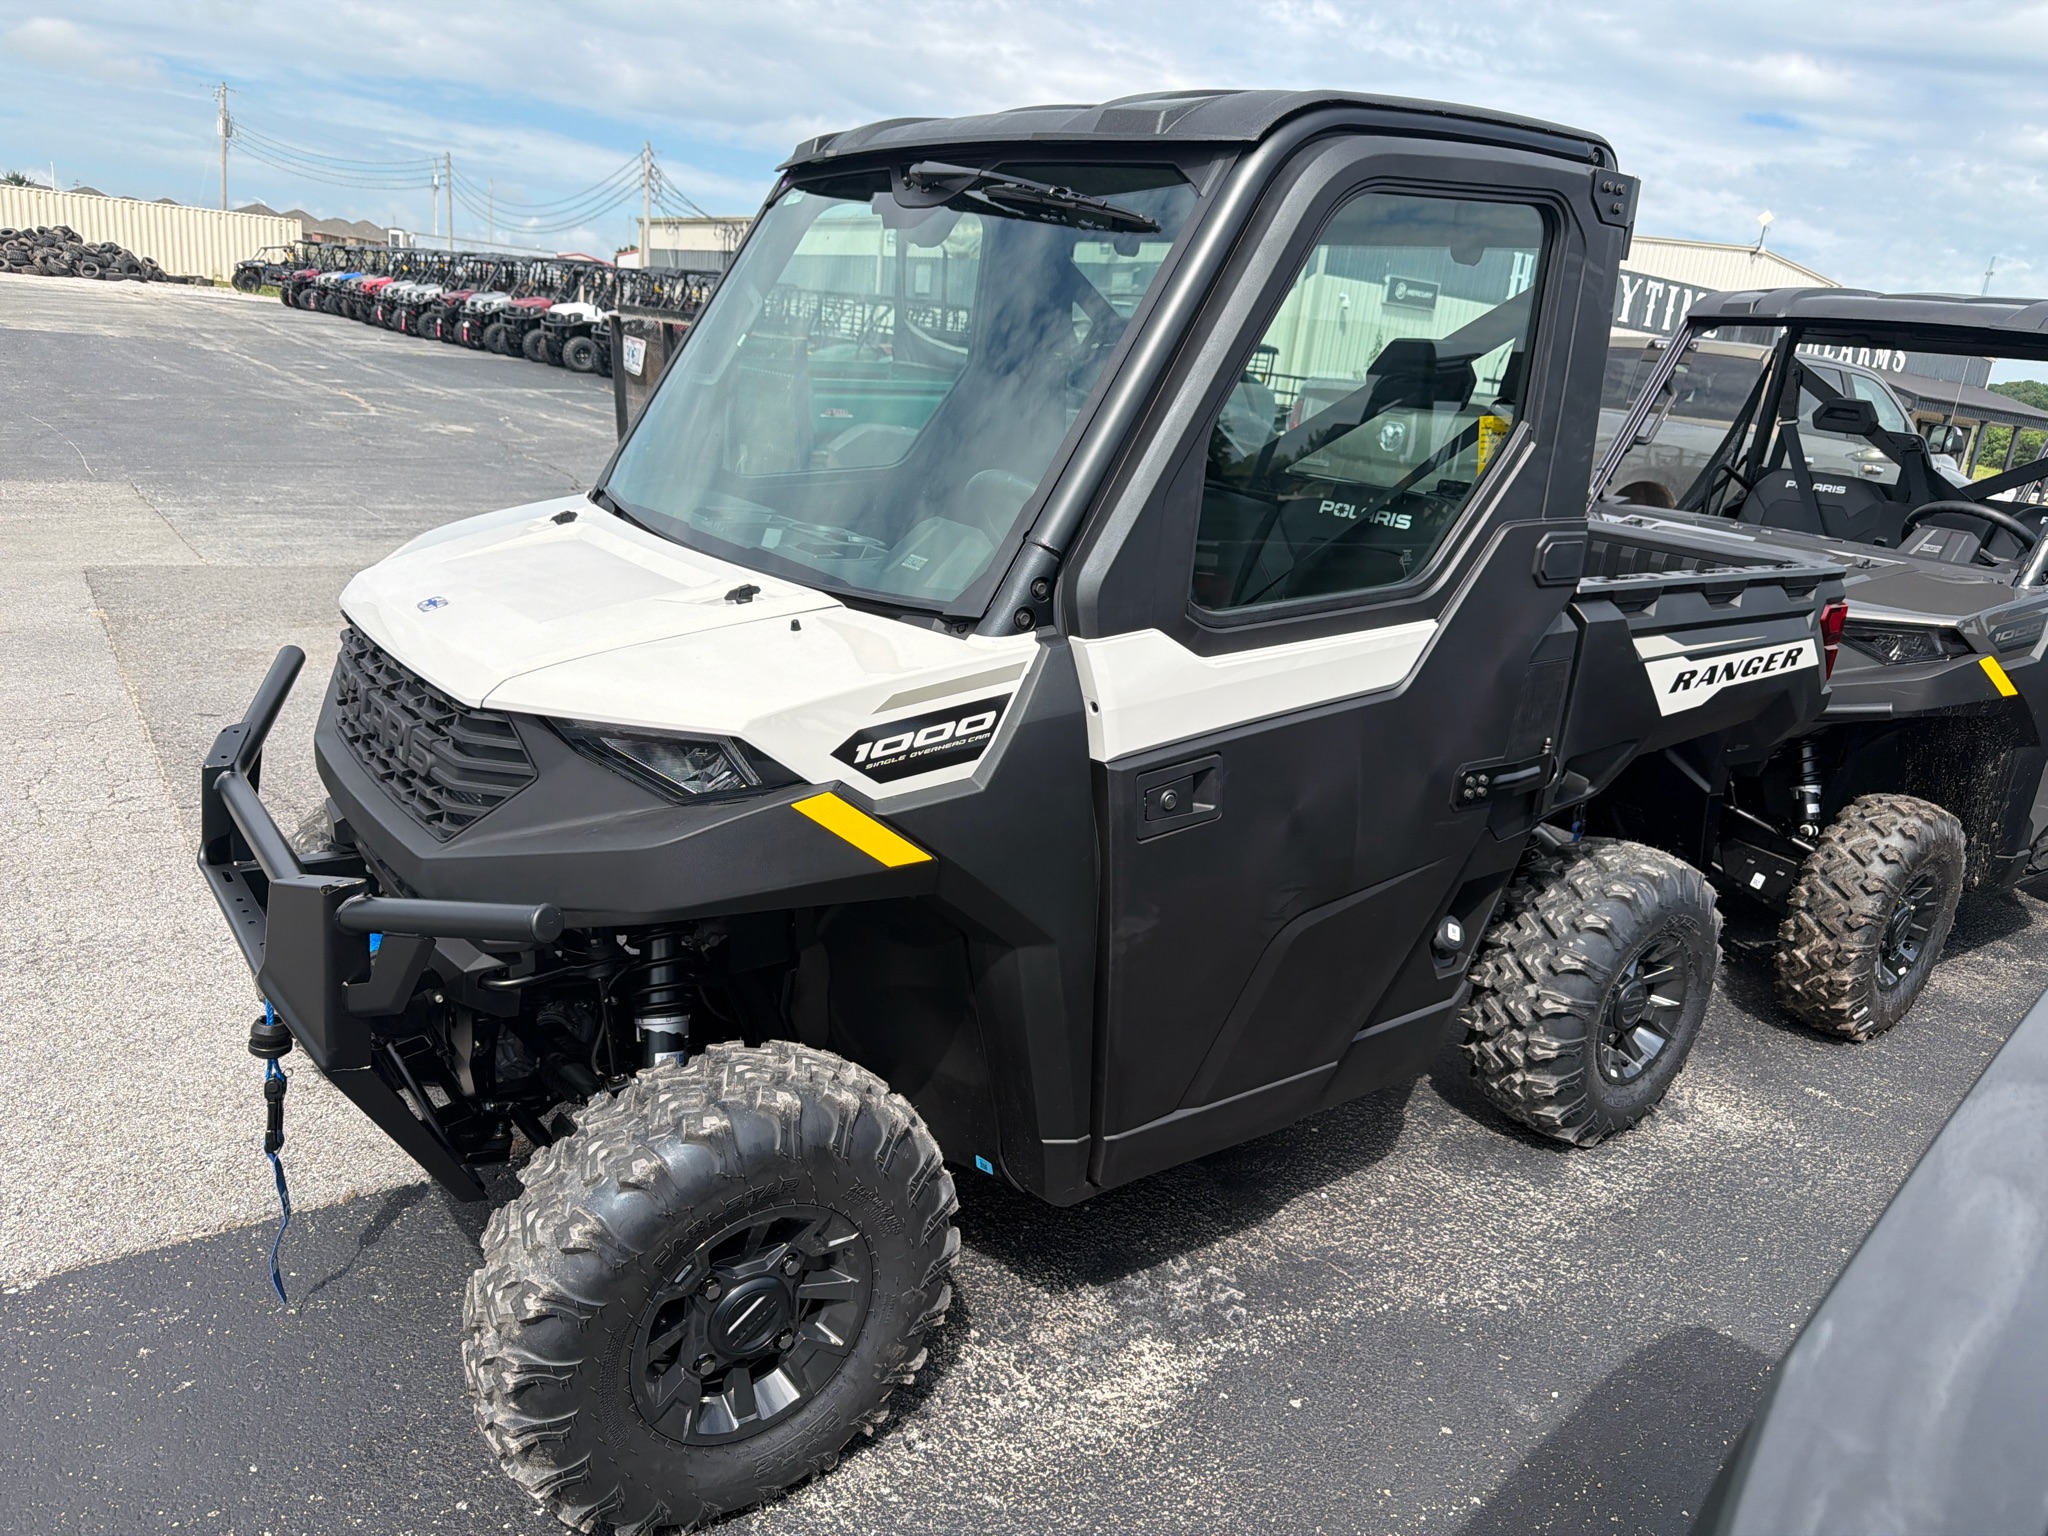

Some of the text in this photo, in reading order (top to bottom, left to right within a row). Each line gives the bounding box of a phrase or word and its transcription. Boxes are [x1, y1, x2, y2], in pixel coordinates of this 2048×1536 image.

[1785, 480, 1846, 494] PARIS
[1668, 647, 1804, 694] RANGER
[854, 710, 997, 764] 1000
[865, 732, 991, 770] SINGLE OVERHEAD CAM
[652, 1176, 800, 1270] CARLSTAR
